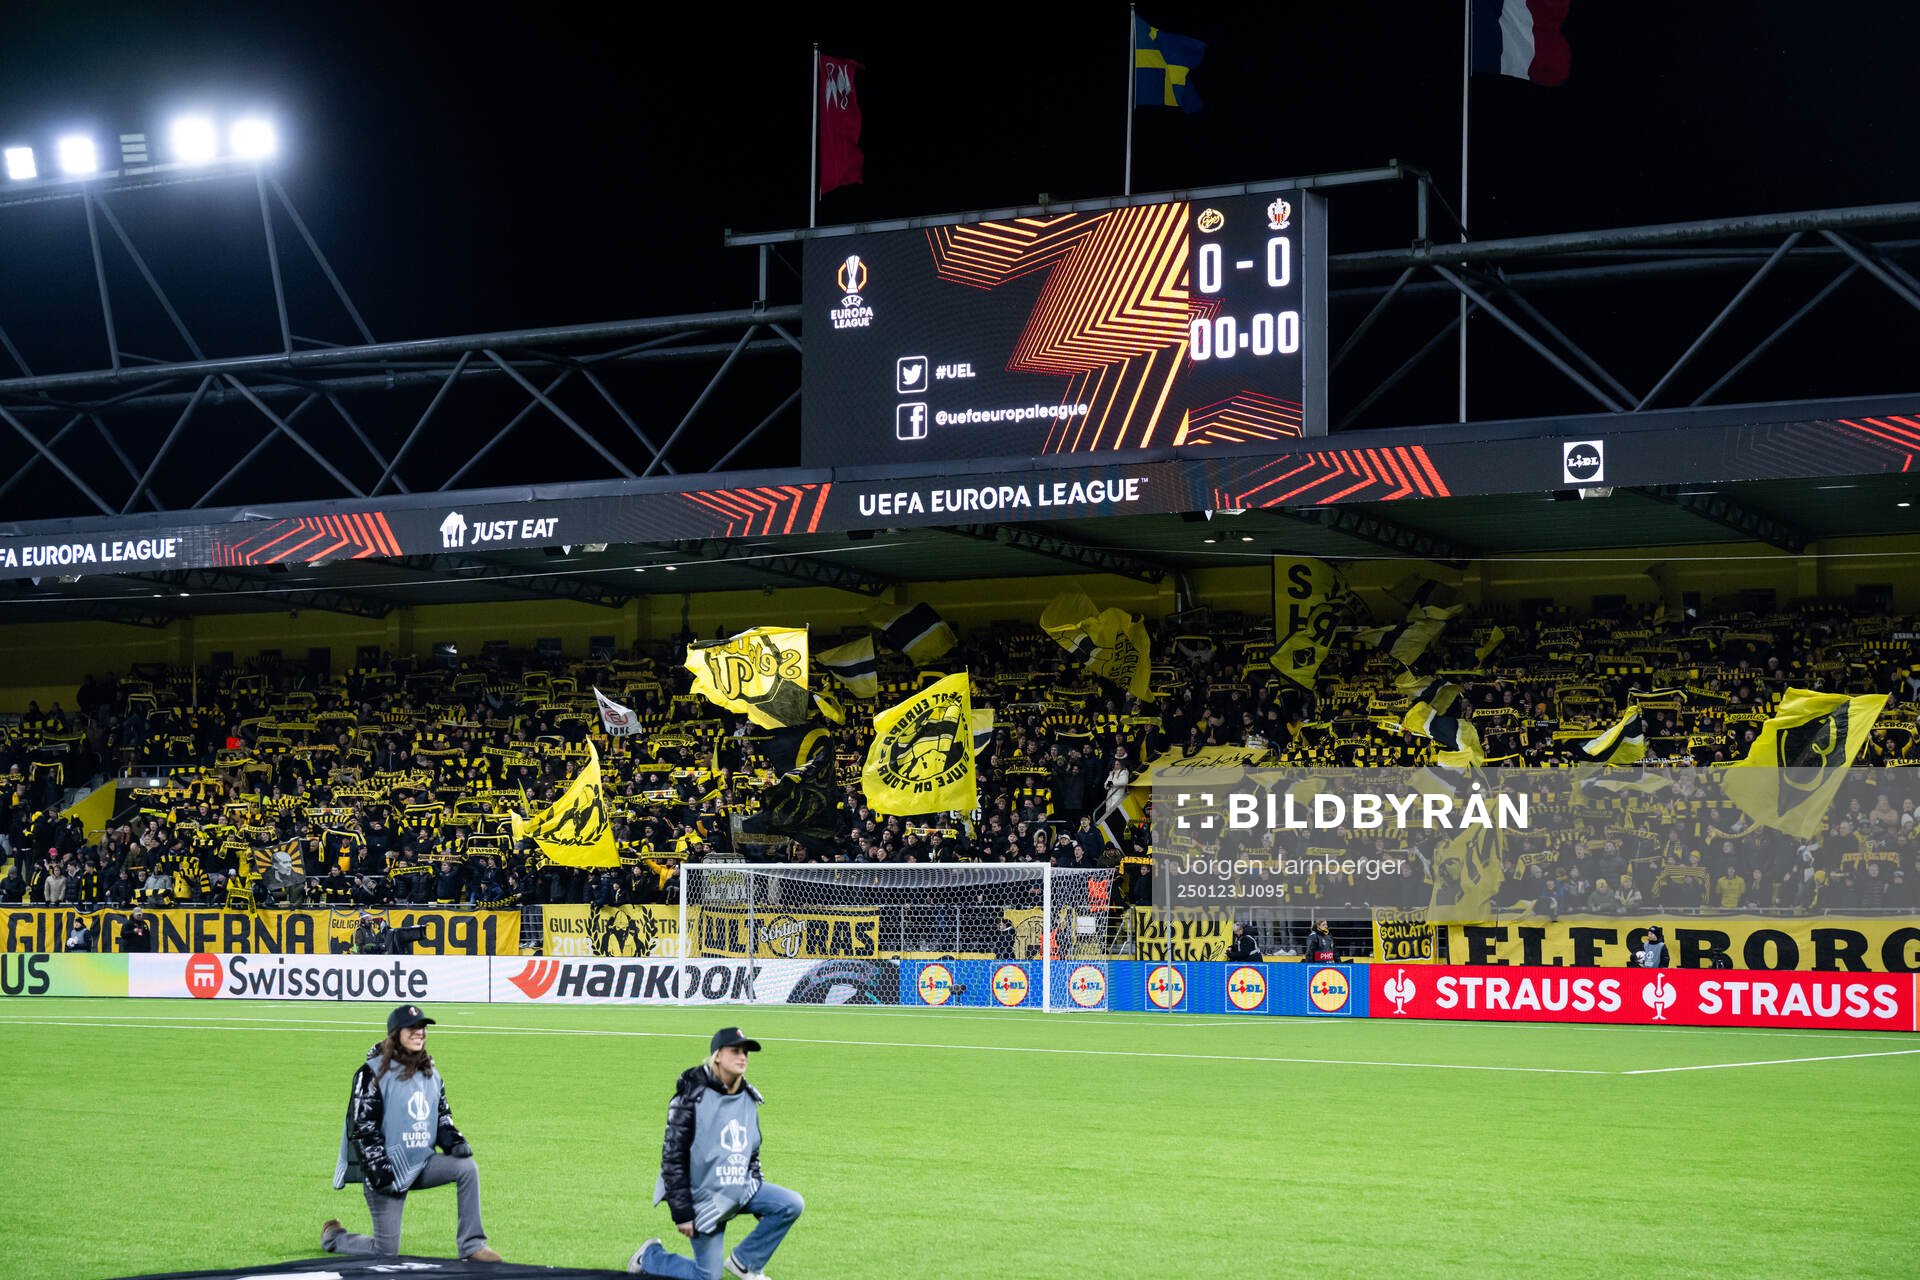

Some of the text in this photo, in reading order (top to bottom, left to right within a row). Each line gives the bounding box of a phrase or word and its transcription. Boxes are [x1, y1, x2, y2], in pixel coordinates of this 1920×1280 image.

[1199, 244, 1222, 293] 0
[1267, 236, 1290, 287] 0
[830, 307, 874, 320] EUROPA
[834, 317, 870, 329] LEAGUE
[935, 364, 975, 379] #UEL
[935, 402, 1088, 425] @uefaeuropaleague
[859, 491, 925, 516] UEFA
[931, 485, 1032, 512] EUROPA
[1038, 478, 1140, 506] LEAGUE
[471, 518, 559, 545] JUST EAT
[22, 543, 97, 567] EUROPA
[101, 538, 176, 561] LEAGUE
[7, 911, 315, 953] GUIGNERNA
[1384, 938, 1431, 959] 2016
[228, 955, 428, 1000] Swissquote
[1436, 976, 1622, 1013] STRAUSS
[1698, 980, 1899, 1019] STRAUSS
[402, 1132, 431, 1141] EURO
[406, 1140, 429, 1149] LEAG
[715, 1166, 748, 1177] EURO
[719, 1176, 745, 1185] LEAG
